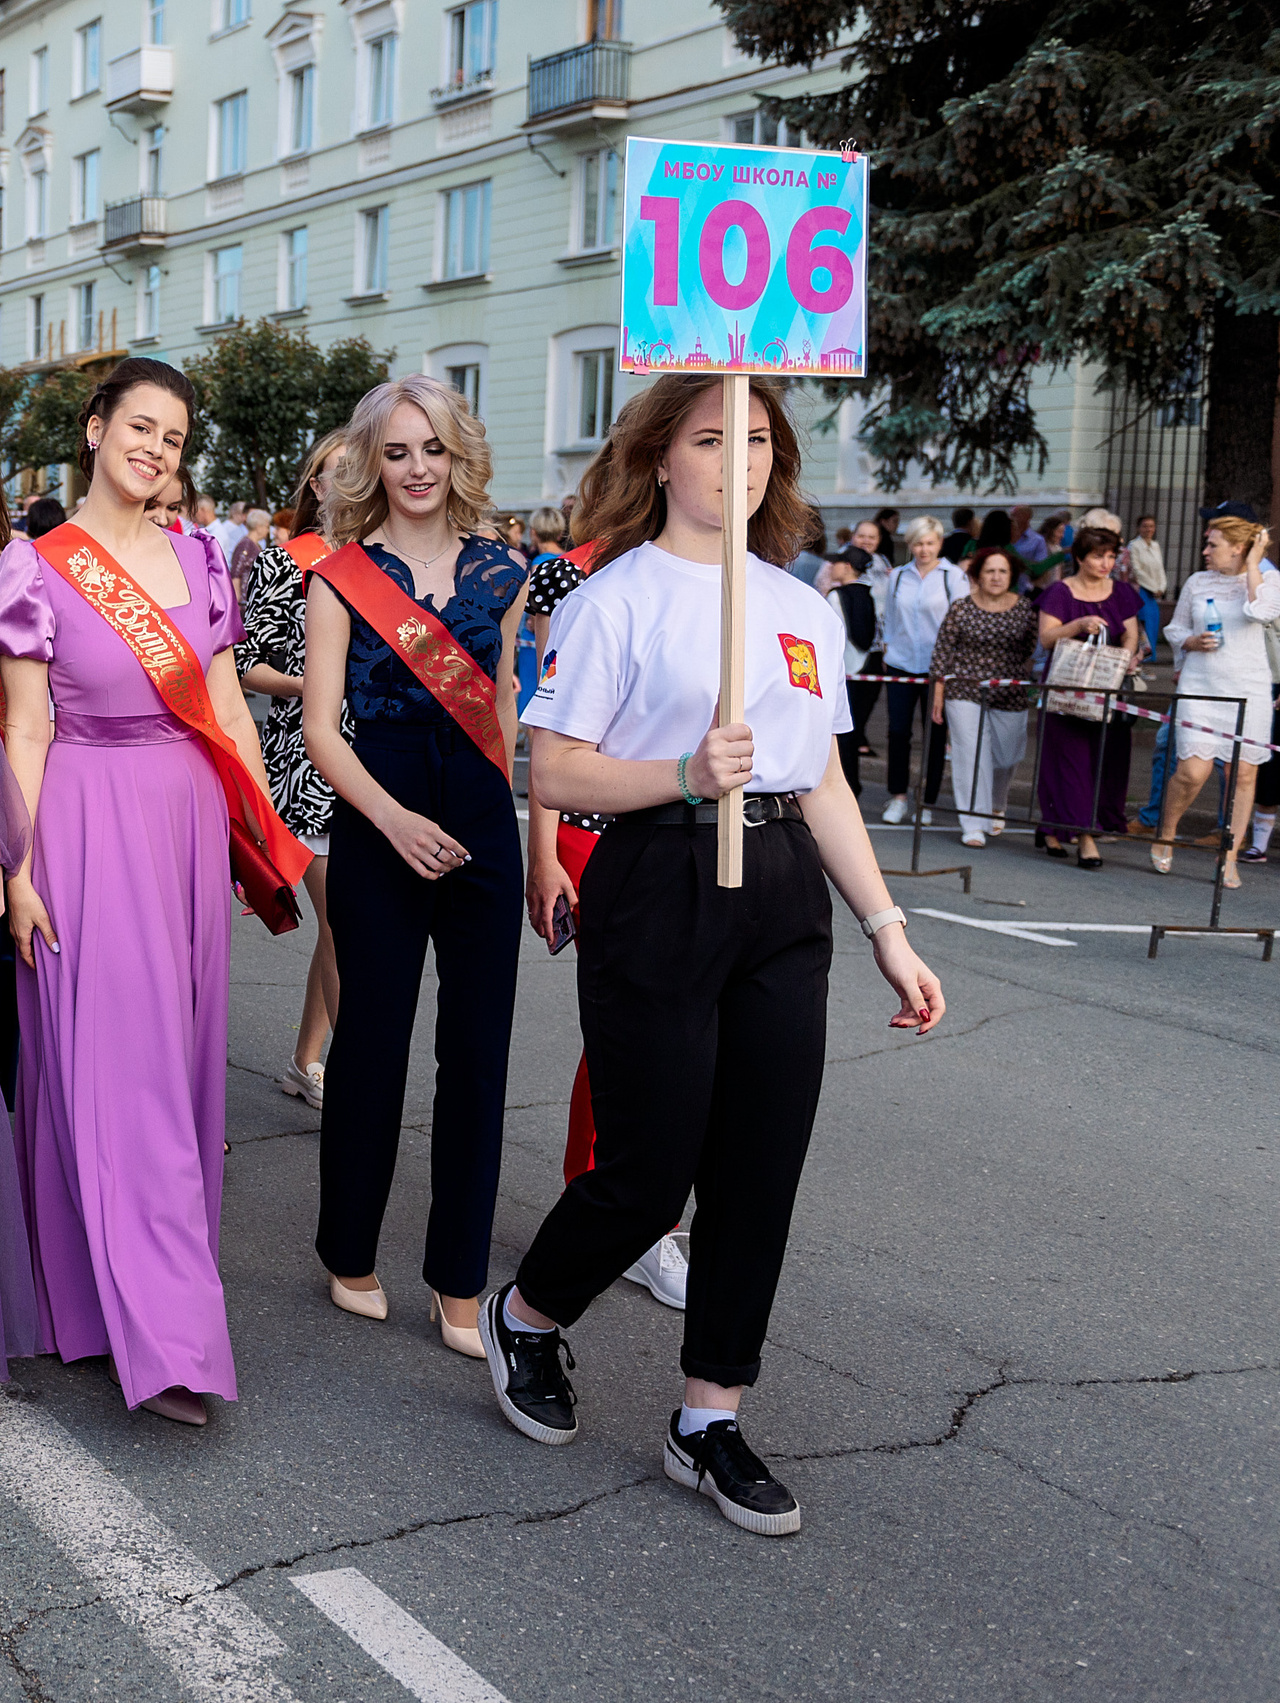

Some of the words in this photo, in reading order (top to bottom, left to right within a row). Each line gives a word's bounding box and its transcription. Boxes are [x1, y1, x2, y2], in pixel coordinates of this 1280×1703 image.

[664, 160, 725, 182] МБОУ
[732, 165, 809, 188] ШКОЛА
[817, 172, 838, 190] №
[640, 195, 854, 315] 106
